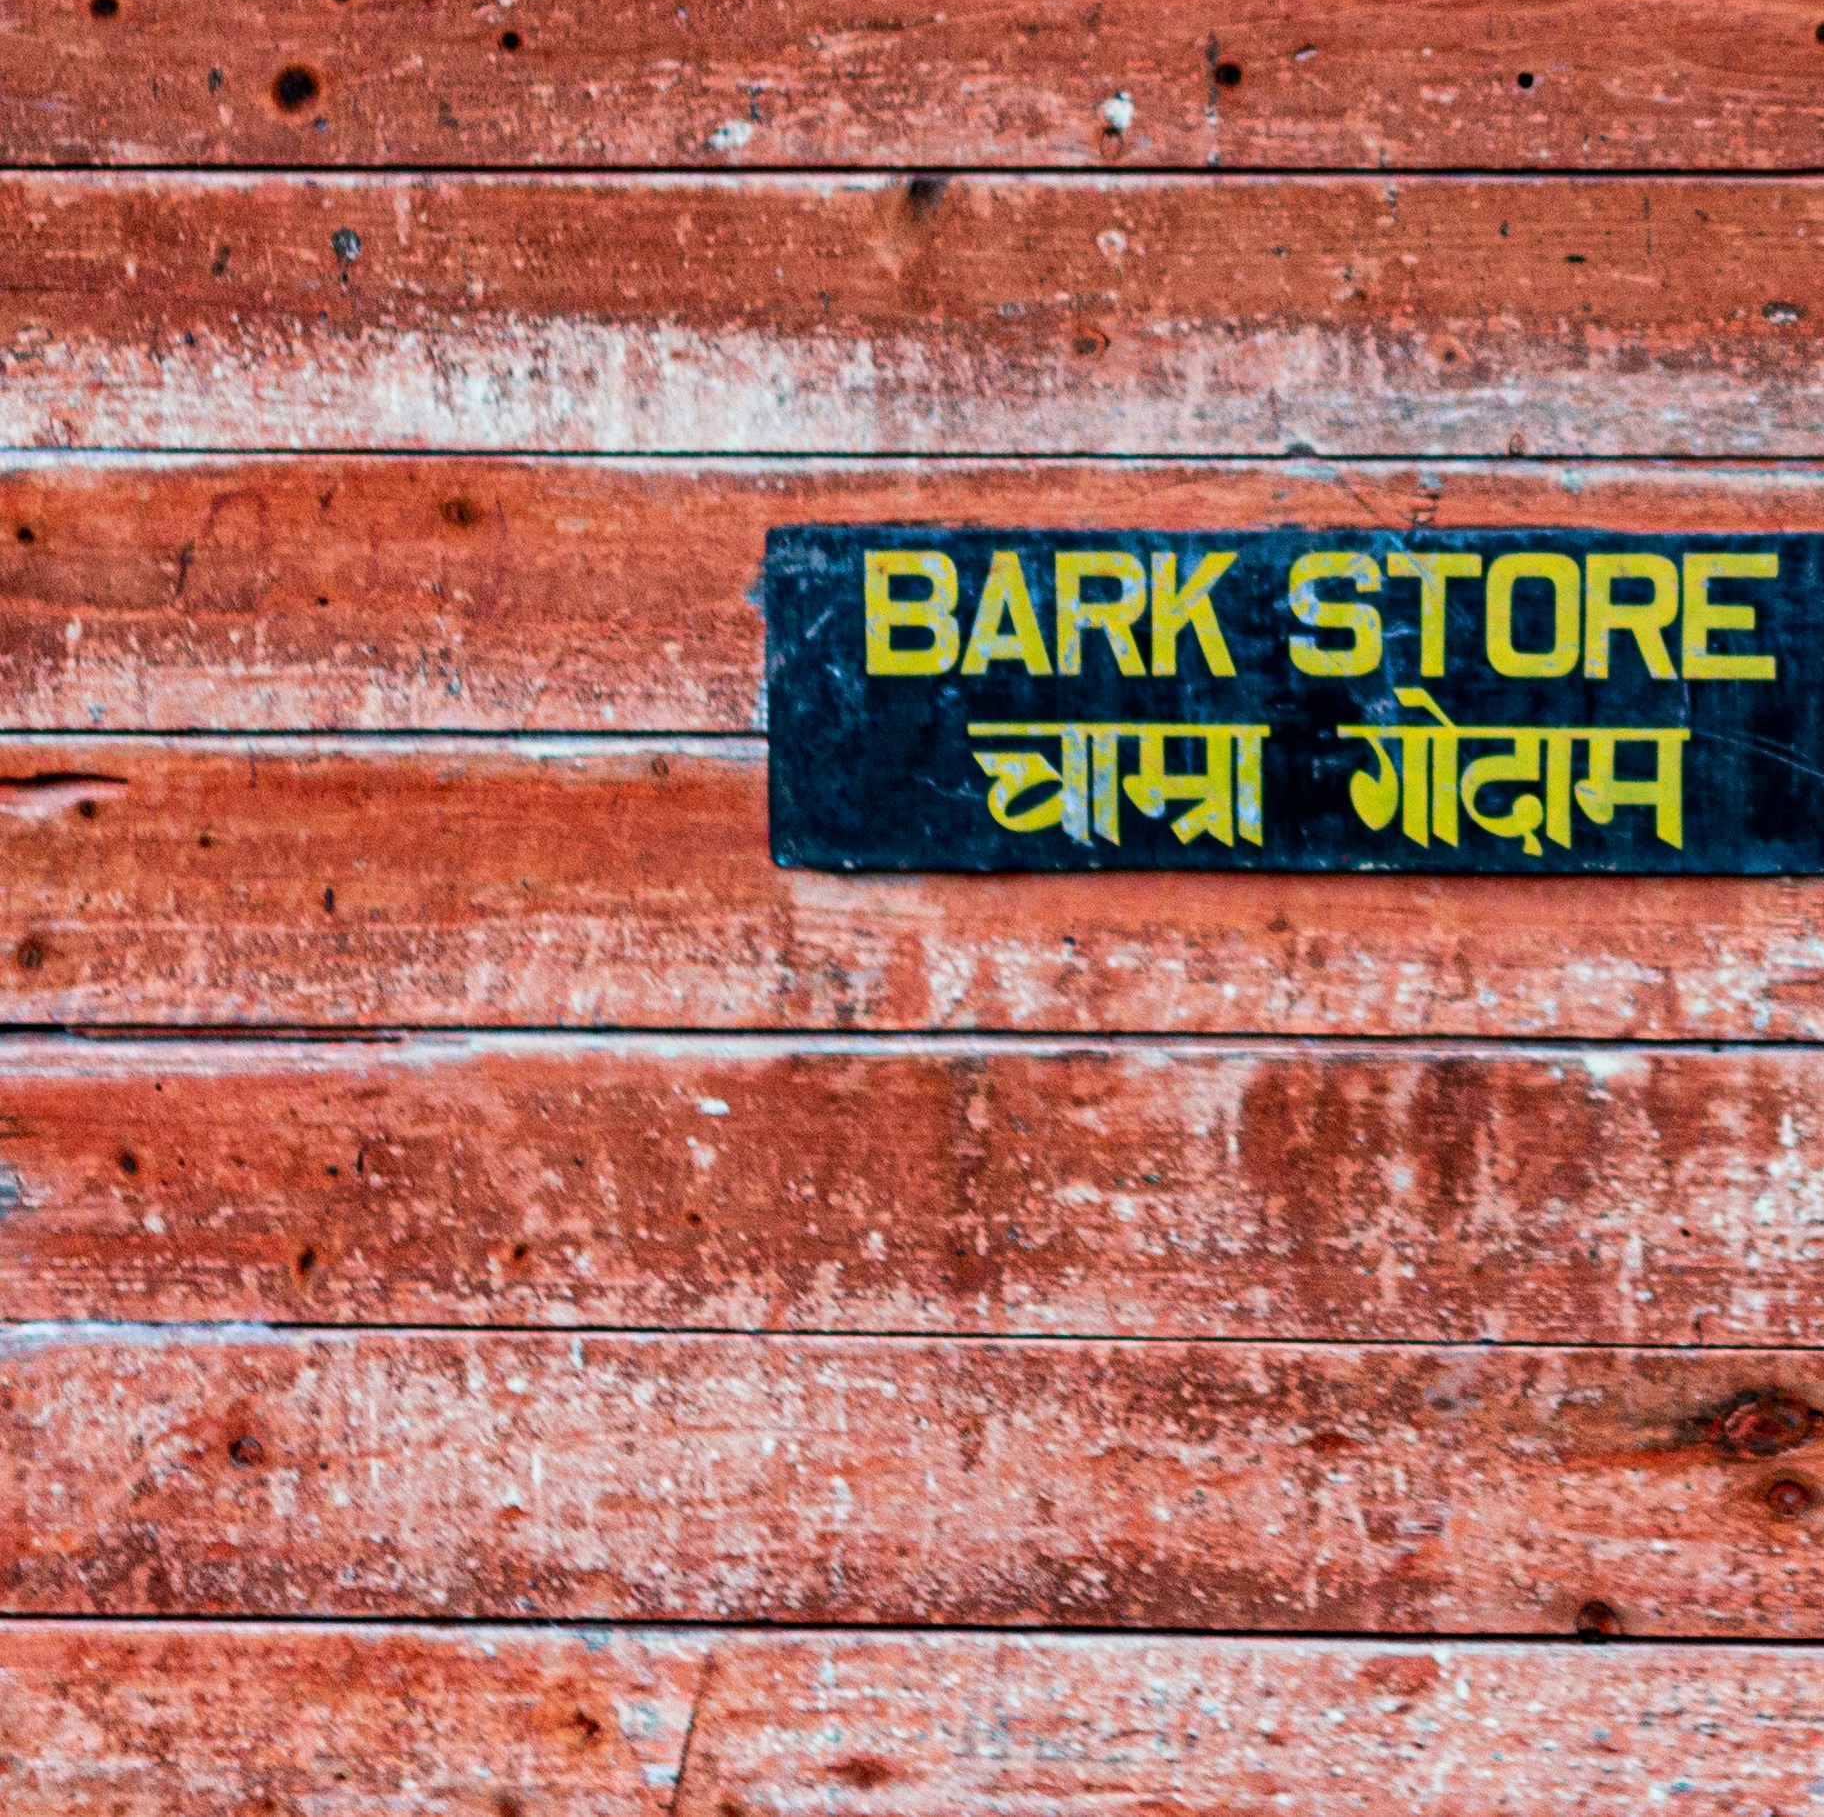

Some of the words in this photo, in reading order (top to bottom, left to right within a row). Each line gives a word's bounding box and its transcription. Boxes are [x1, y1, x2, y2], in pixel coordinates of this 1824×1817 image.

[863, 550, 1238, 678] BARK
[1287, 551, 1779, 681] STORE
[966, 721, 1271, 847] चाम्रा
[1336, 687, 1691, 856] गोदाम
